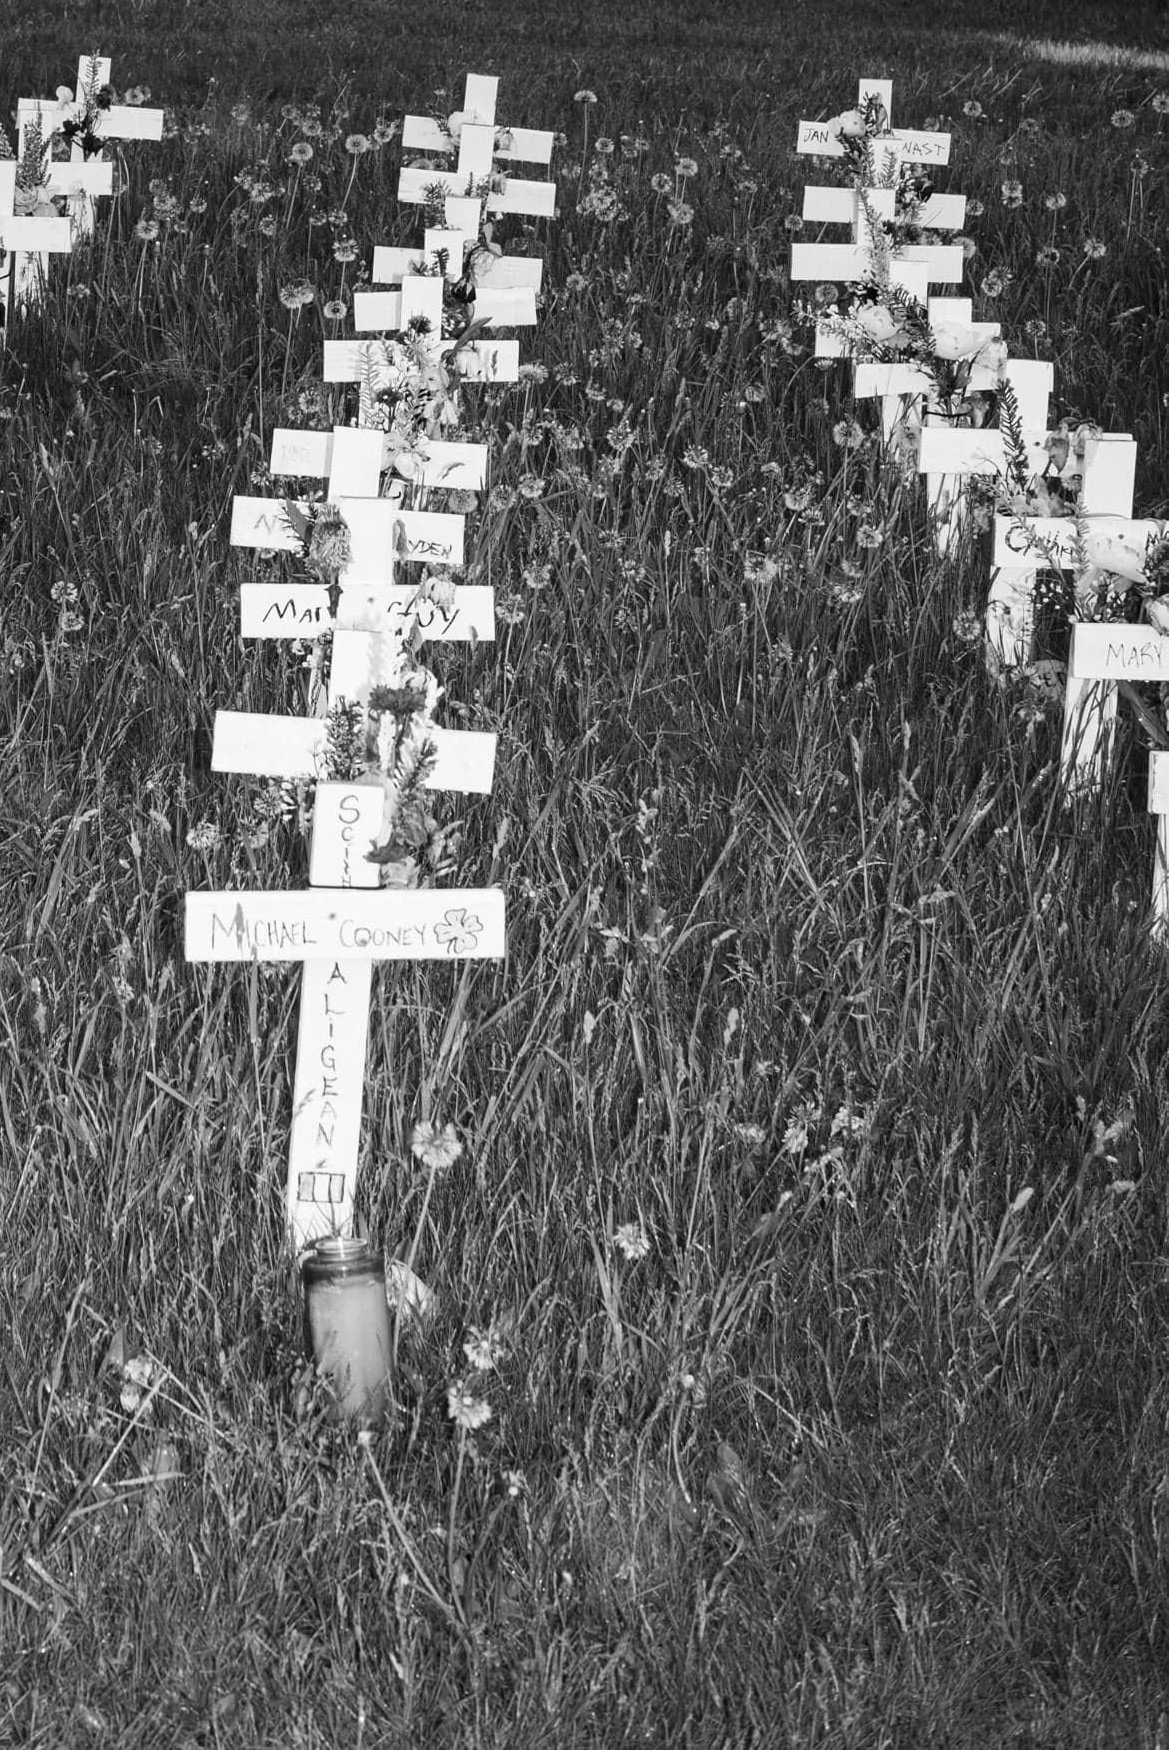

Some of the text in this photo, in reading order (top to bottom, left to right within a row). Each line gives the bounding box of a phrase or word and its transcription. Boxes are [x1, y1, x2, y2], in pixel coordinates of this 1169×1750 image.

[803, 128, 829, 143] JAN
[1106, 642, 1163, 668] MARY
[211, 910, 427, 950] MICHAEL COONEY
